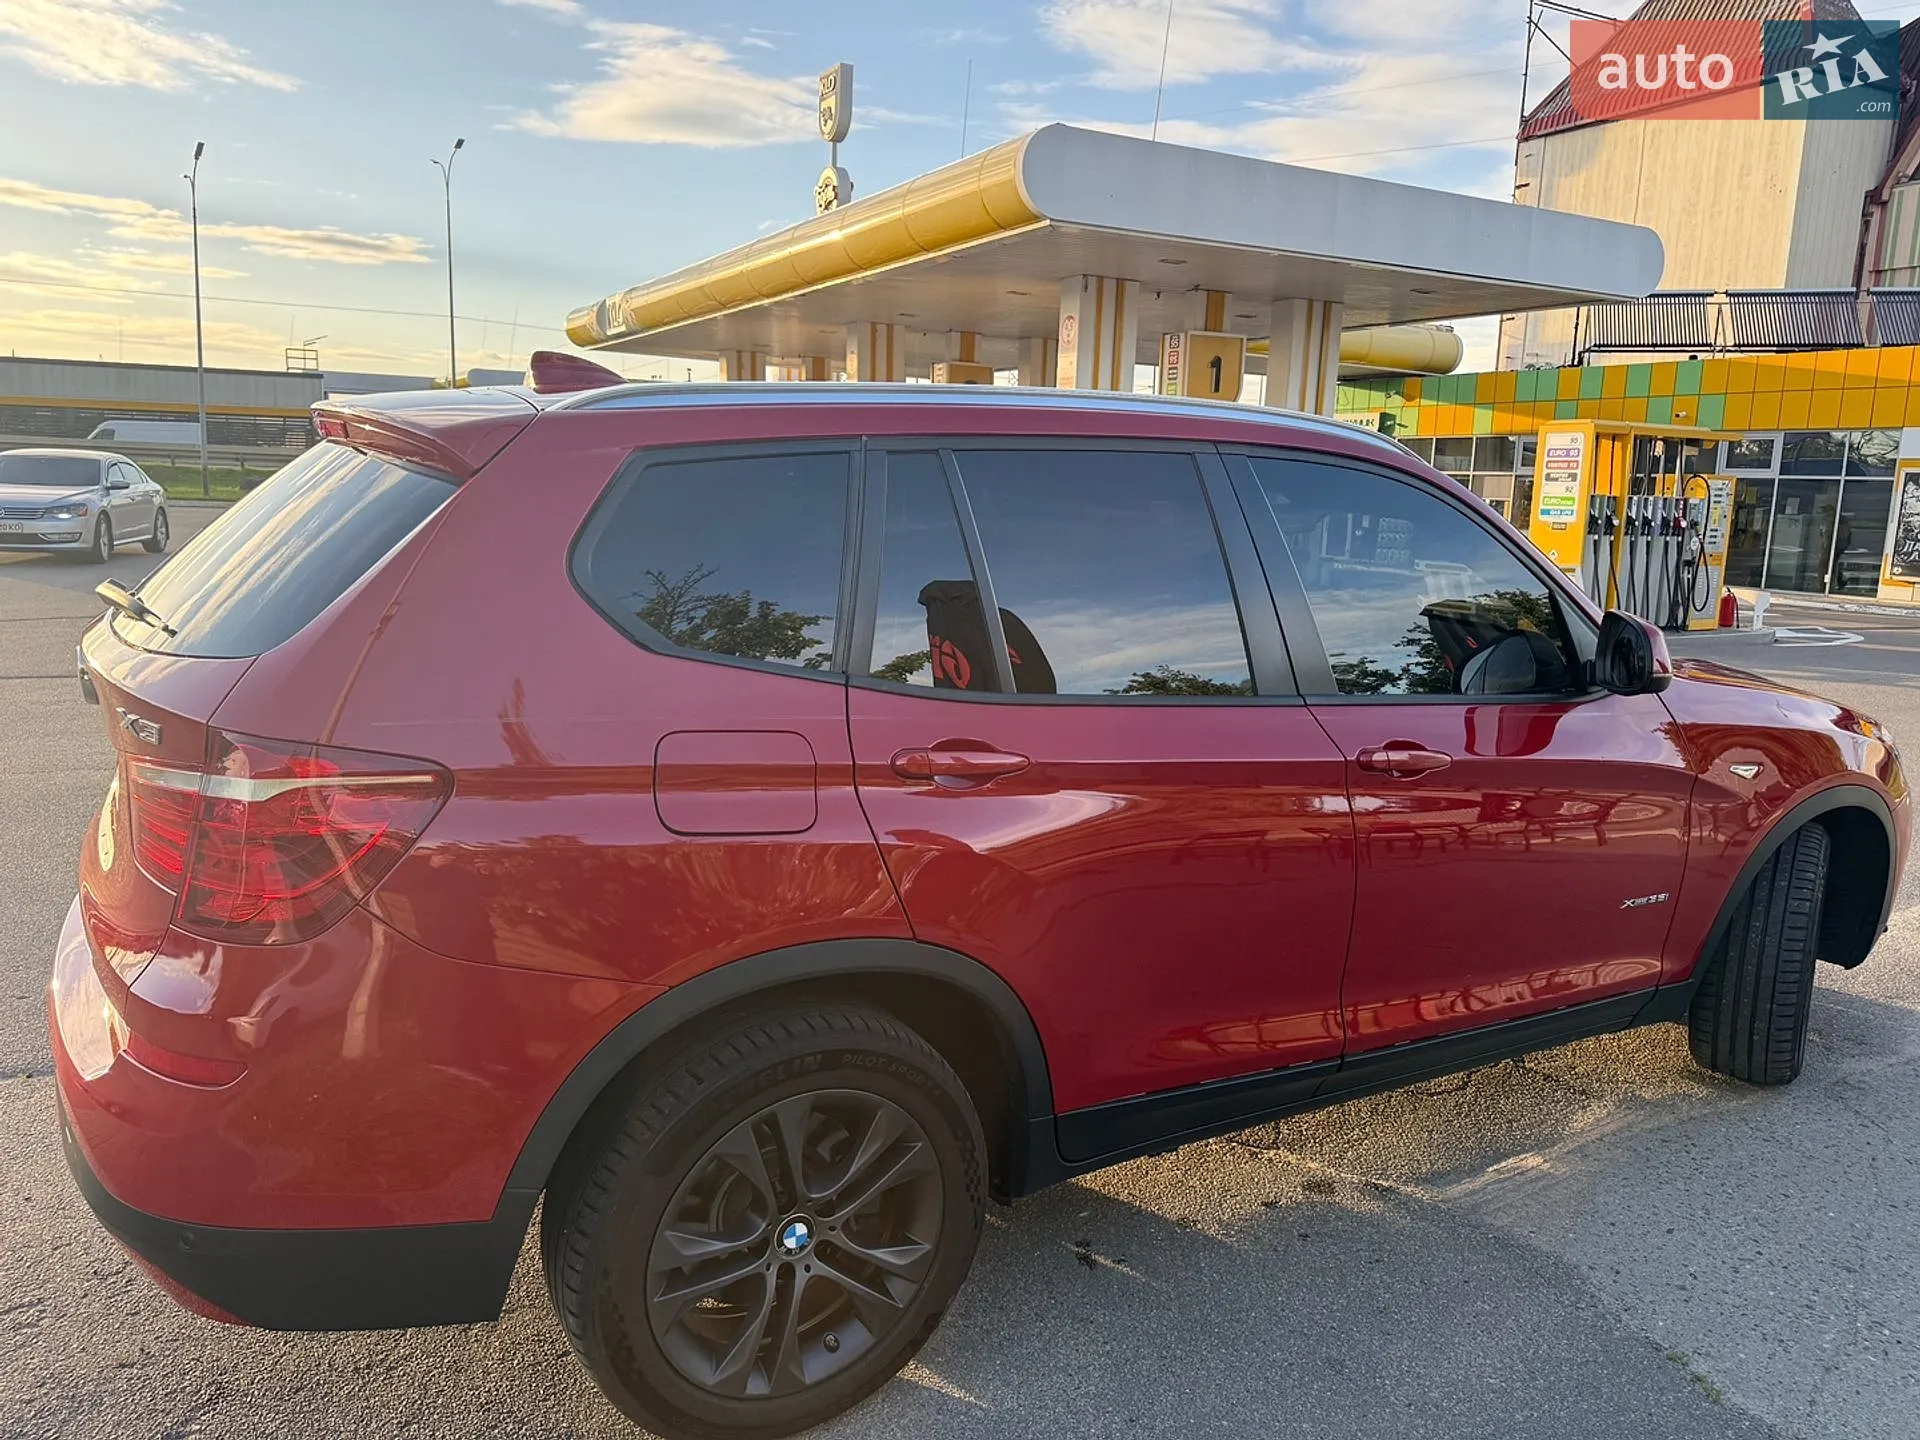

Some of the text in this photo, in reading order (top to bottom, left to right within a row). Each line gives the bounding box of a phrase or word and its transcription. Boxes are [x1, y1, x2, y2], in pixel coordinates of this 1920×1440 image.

[1208, 355, 1223, 393] 1
[116, 707, 162, 745] X3
[841, 1053, 888, 1068] PILOT
